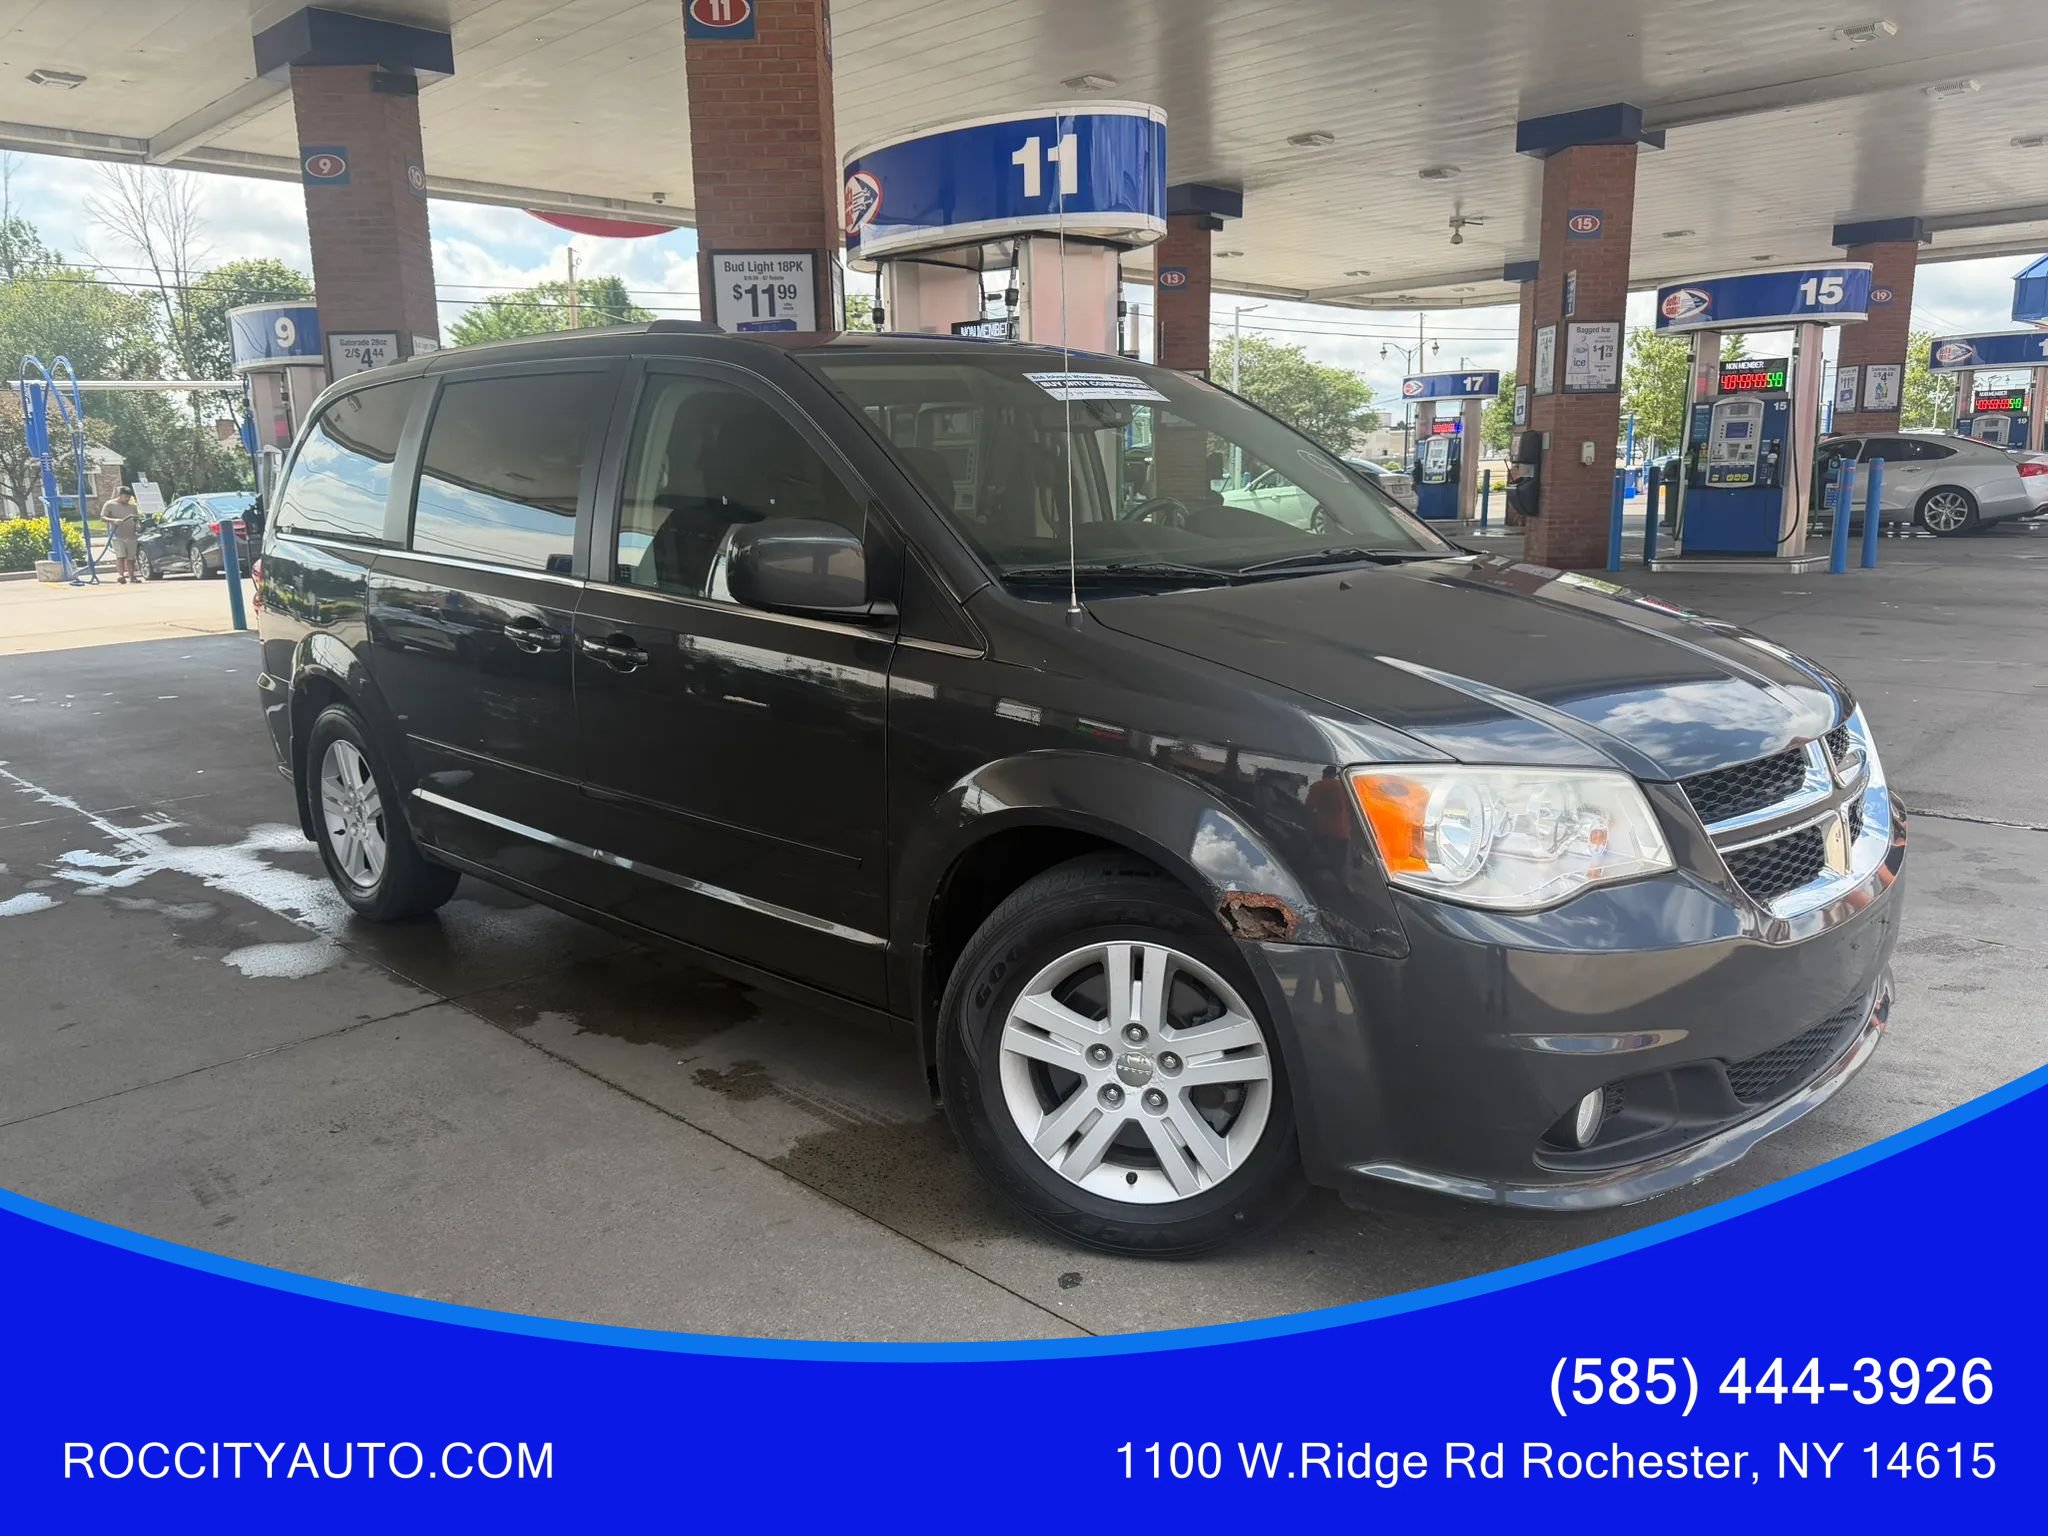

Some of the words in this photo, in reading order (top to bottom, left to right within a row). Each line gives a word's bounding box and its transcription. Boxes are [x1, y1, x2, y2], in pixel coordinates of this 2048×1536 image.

[709, 0, 731, 20] 11
[318, 158, 332, 174] 9
[1012, 134, 1077, 197] 11
[410, 168, 421, 186] 10
[1577, 217, 1592, 230] 15
[724, 261, 744, 272] Bud
[748, 261, 774, 275] Light
[778, 261, 804, 272] 18PK
[1166, 273, 1179, 284] 13
[1800, 276, 1844, 306] 15
[1876, 291, 1887, 300] 19
[275, 317, 295, 348] 9
[977, 321, 1008, 337] MEMBE
[1576, 326, 1600, 335] Bagged
[1726, 362, 1738, 370] NON
[1739, 361, 1764, 369] MEMBER
[1463, 376, 1484, 392] 17
[1774, 401, 1787, 411] 15
